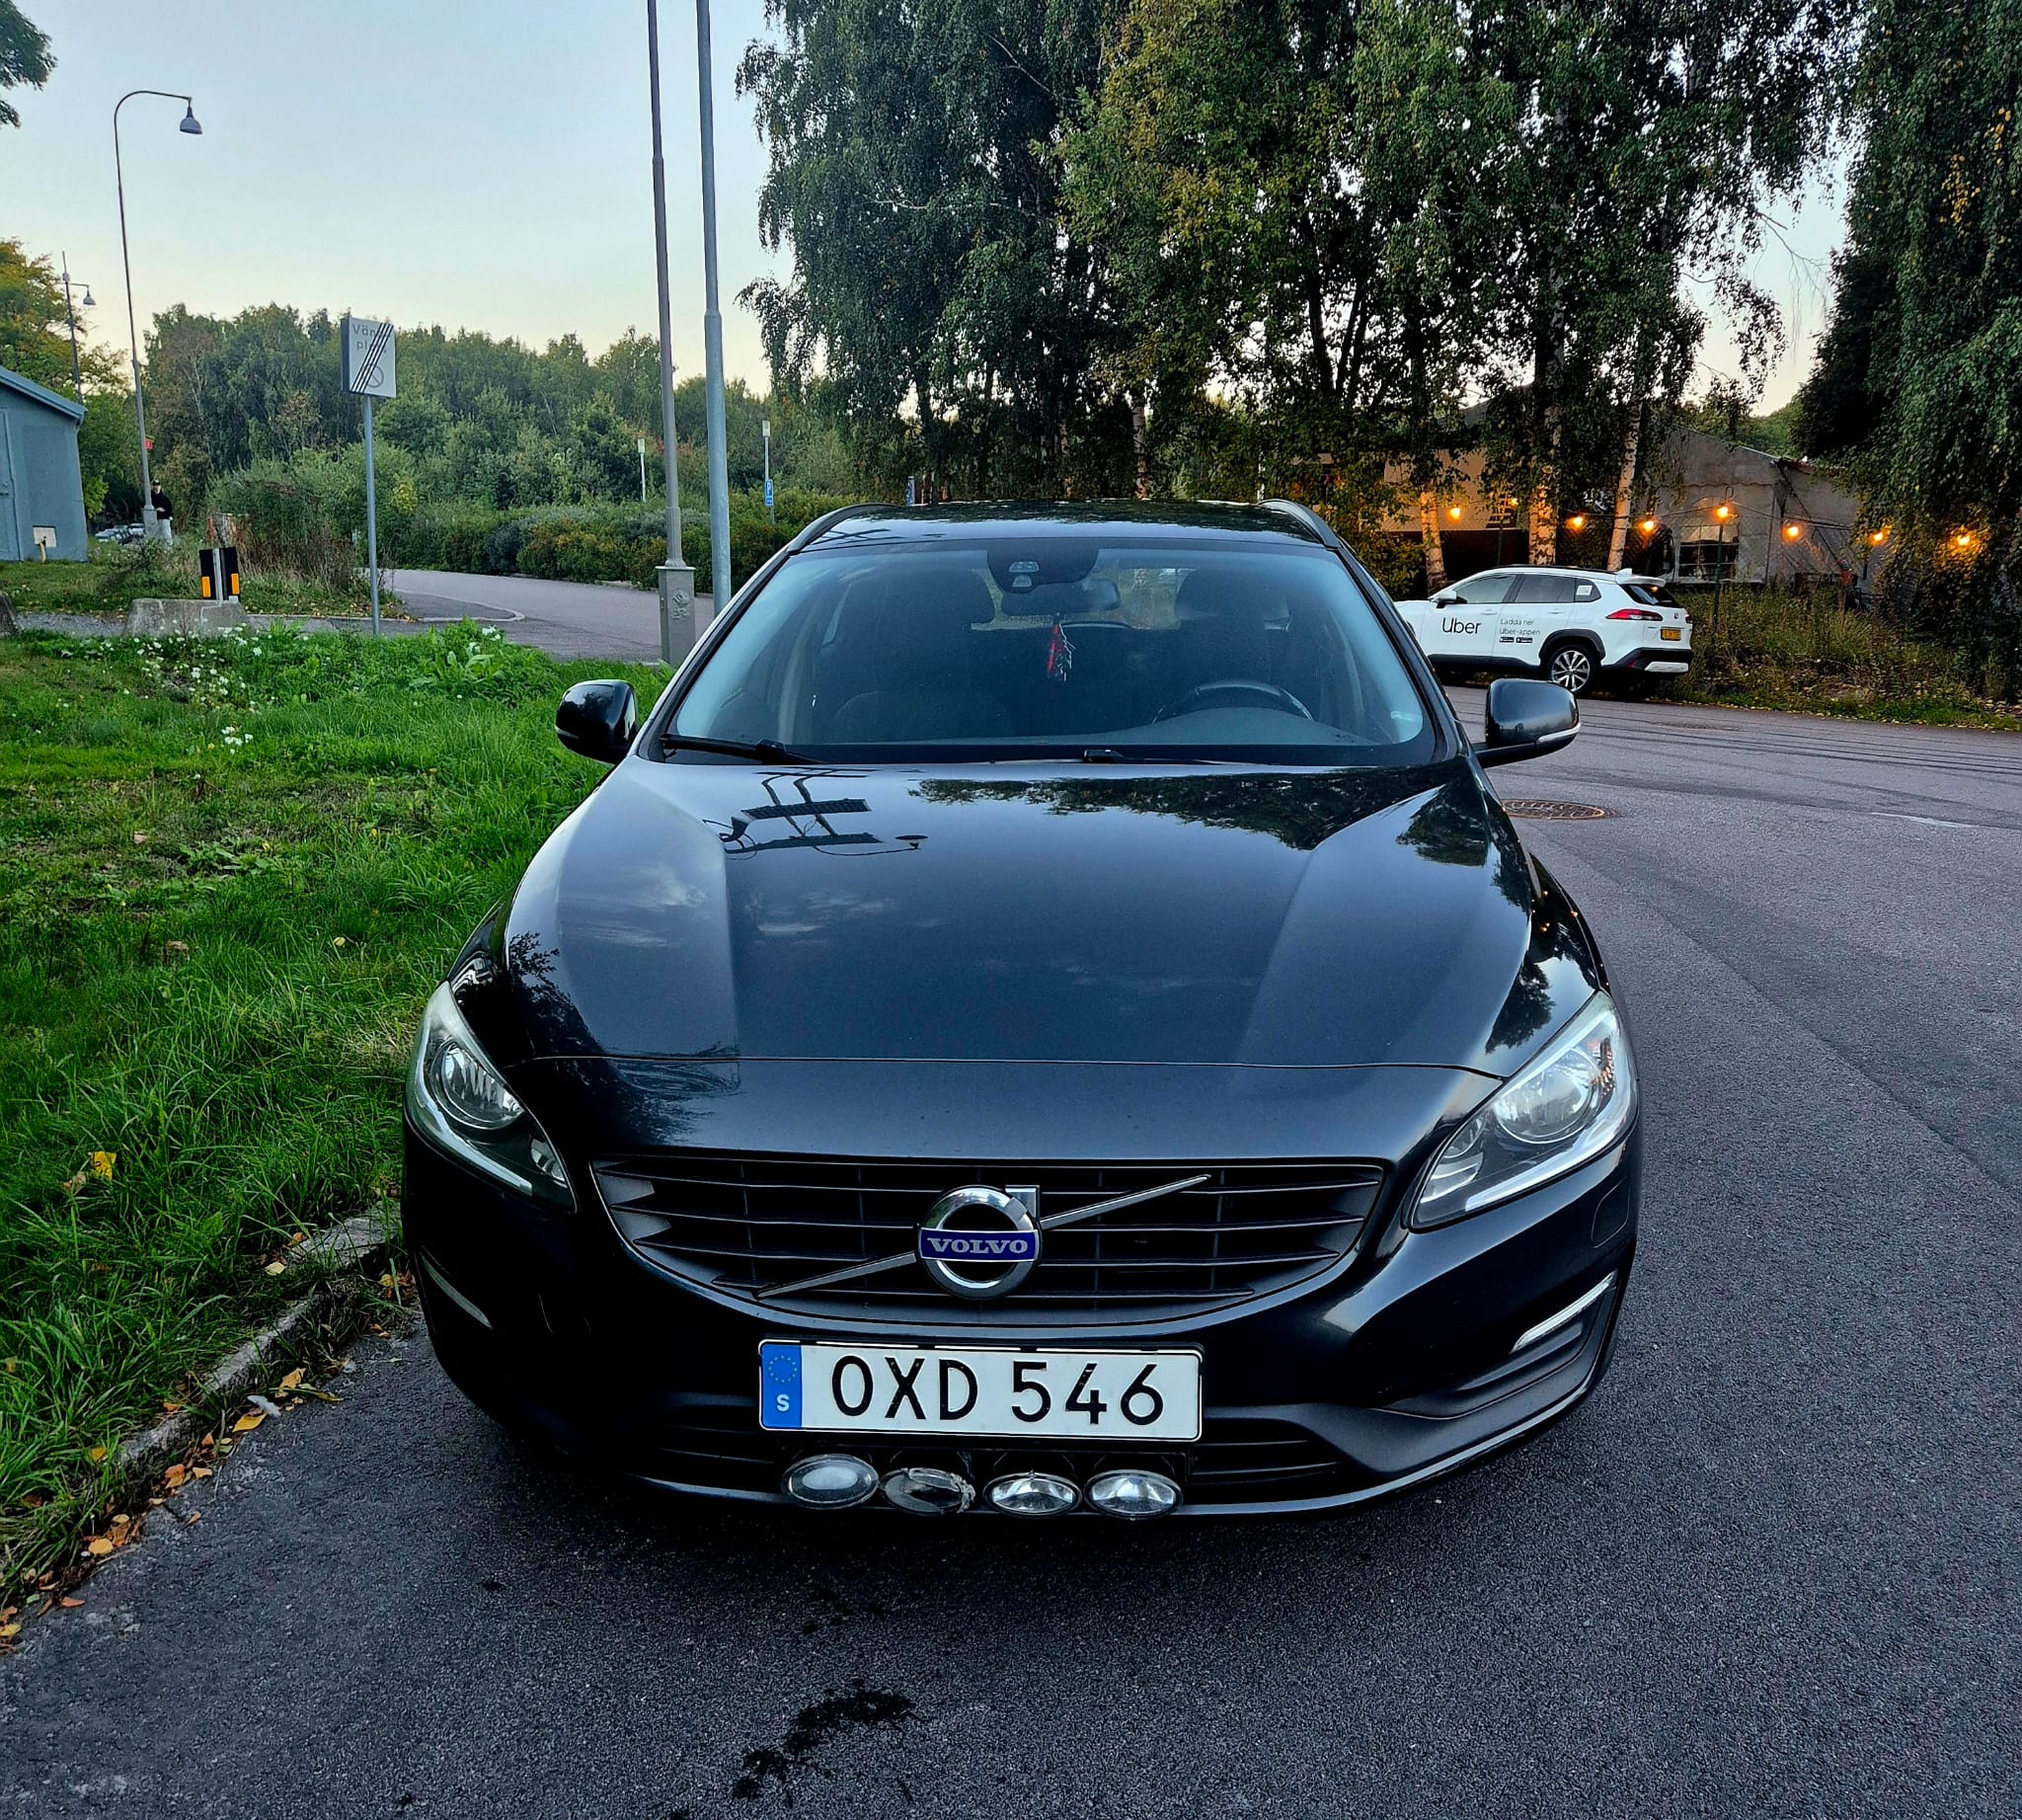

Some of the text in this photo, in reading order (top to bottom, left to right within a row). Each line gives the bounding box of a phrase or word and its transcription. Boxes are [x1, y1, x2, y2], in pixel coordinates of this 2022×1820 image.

[352, 323, 376, 336] Vän
[1442, 617, 1481, 634] Uber
[927, 1237, 1028, 1253] VOLVO
[831, 1355, 1164, 1426] OXD 546
[776, 1394, 790, 1412] S
